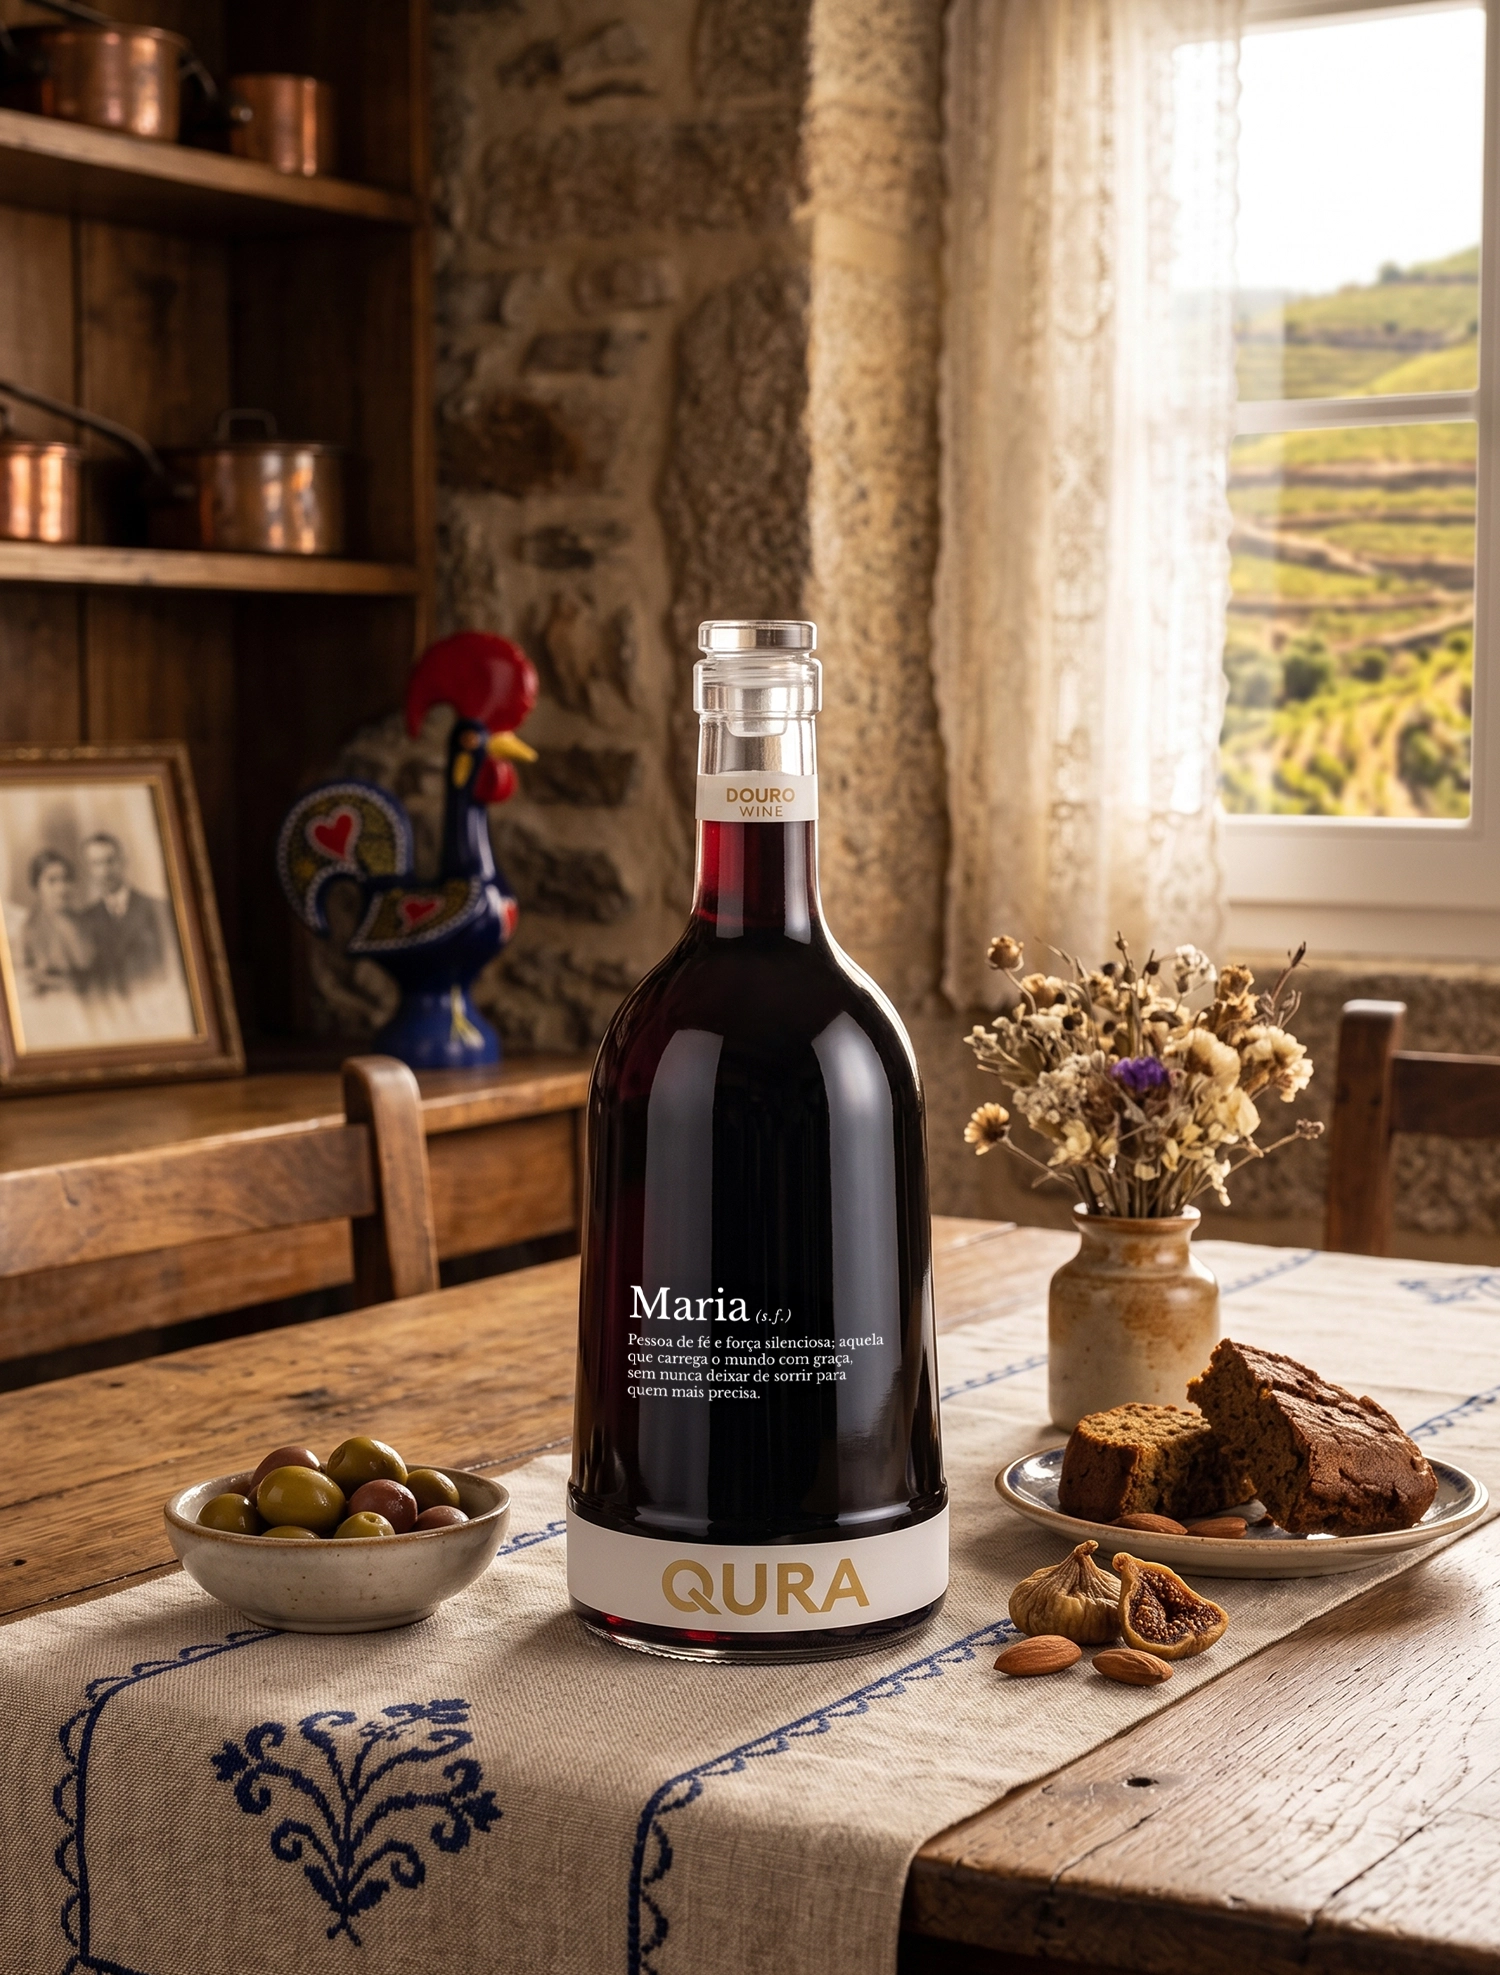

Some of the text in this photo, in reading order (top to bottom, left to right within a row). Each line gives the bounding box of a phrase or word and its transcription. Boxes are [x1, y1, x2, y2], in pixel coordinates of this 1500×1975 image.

[726, 788, 795, 803] DOURO
[739, 805, 783, 817] WINE
[630, 1285, 792, 1325] Maria (s.f.)
[627, 1333, 884, 1352] Pessoa de fé e força silenciosa; aquela
[627, 1352, 853, 1368] que carrega o mundo com graça,
[627, 1369, 847, 1384] sem nunca deixar de sorrir para
[627, 1385, 760, 1401] quem mais precisa.
[662, 1558, 870, 1615] QURA
